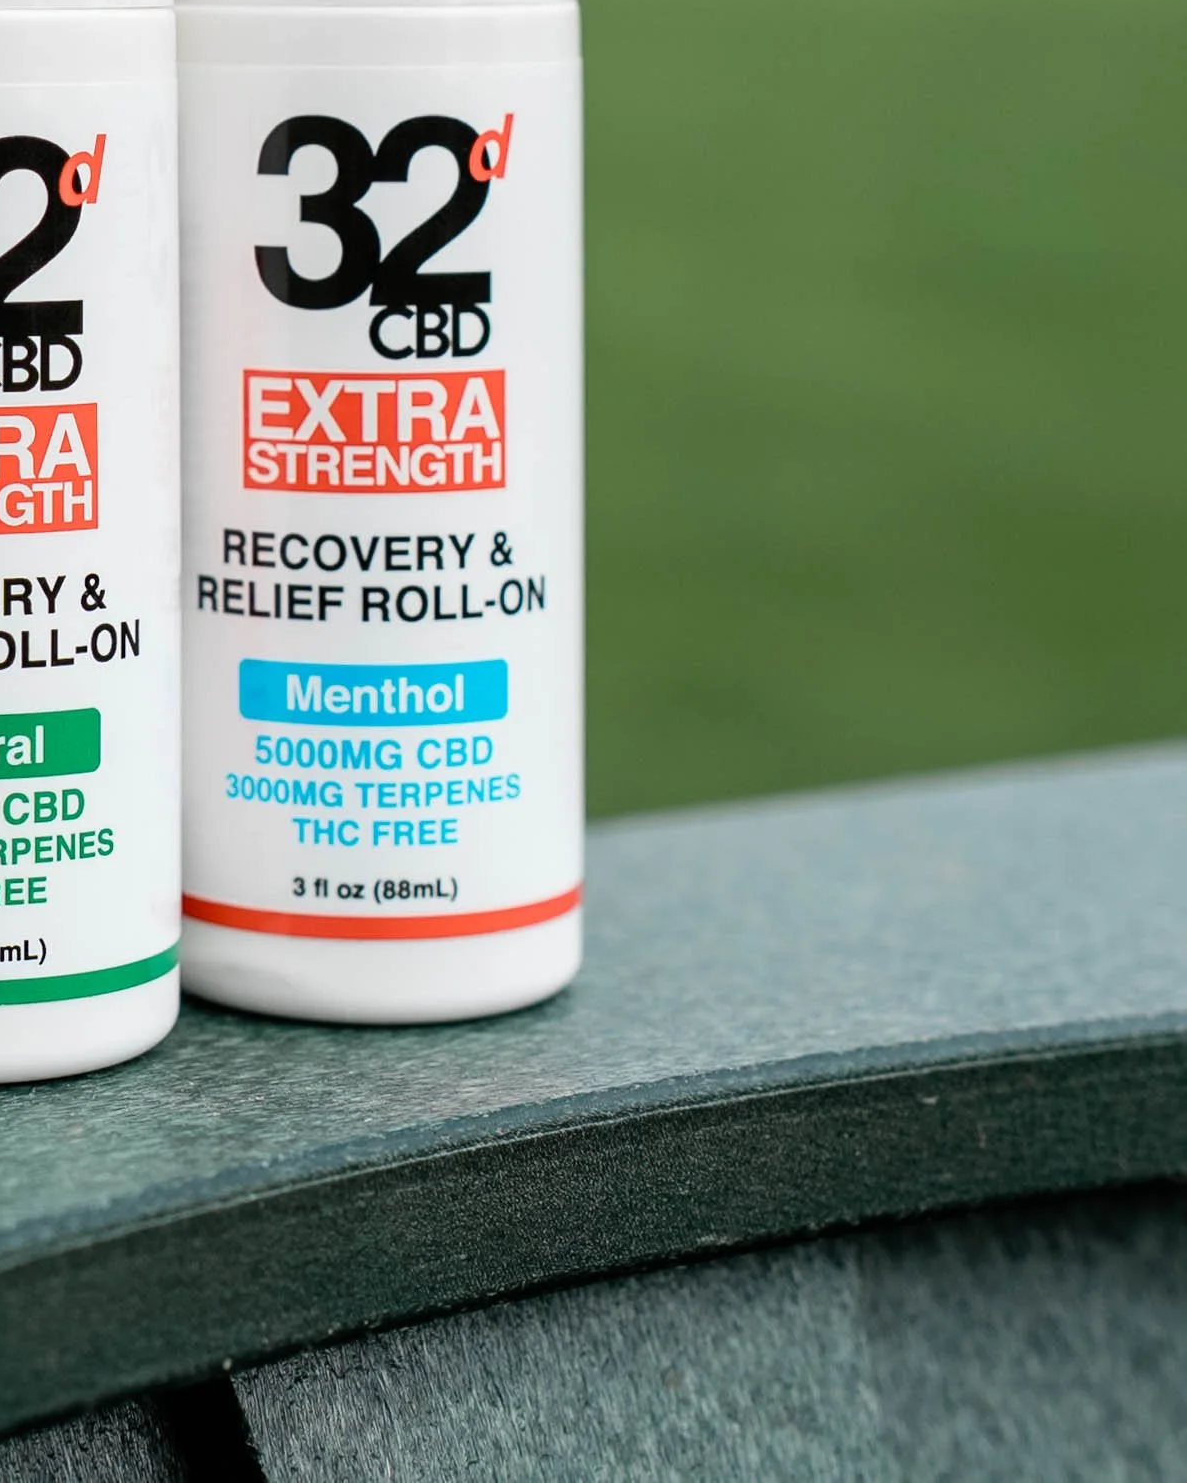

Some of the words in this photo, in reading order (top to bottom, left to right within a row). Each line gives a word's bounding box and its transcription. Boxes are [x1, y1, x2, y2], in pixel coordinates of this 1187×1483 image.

[369, 304, 491, 360] CBD
[248, 377, 500, 443] EXTRA
[248, 441, 502, 486] STRENGTH
[223, 529, 475, 571] RECOVERY
[490, 532, 513, 566] &
[80, 573, 106, 611] &
[197, 575, 344, 621] RELIEF
[361, 576, 545, 623] ROLL-ON
[286, 674, 464, 715] Menthol
[255, 735, 402, 769] 5000MG
[417, 735, 493, 768] CBD
[3, 788, 84, 823] CBD
[226, 773, 342, 808] 3000MG
[355, 774, 521, 808] TERPENES
[293, 818, 360, 846] THC
[373, 818, 458, 846] FREE
[292, 877, 306, 897] 3
[314, 878, 328, 898] fl
[337, 882, 364, 899] oz
[374, 878, 458, 904] (88mL)
